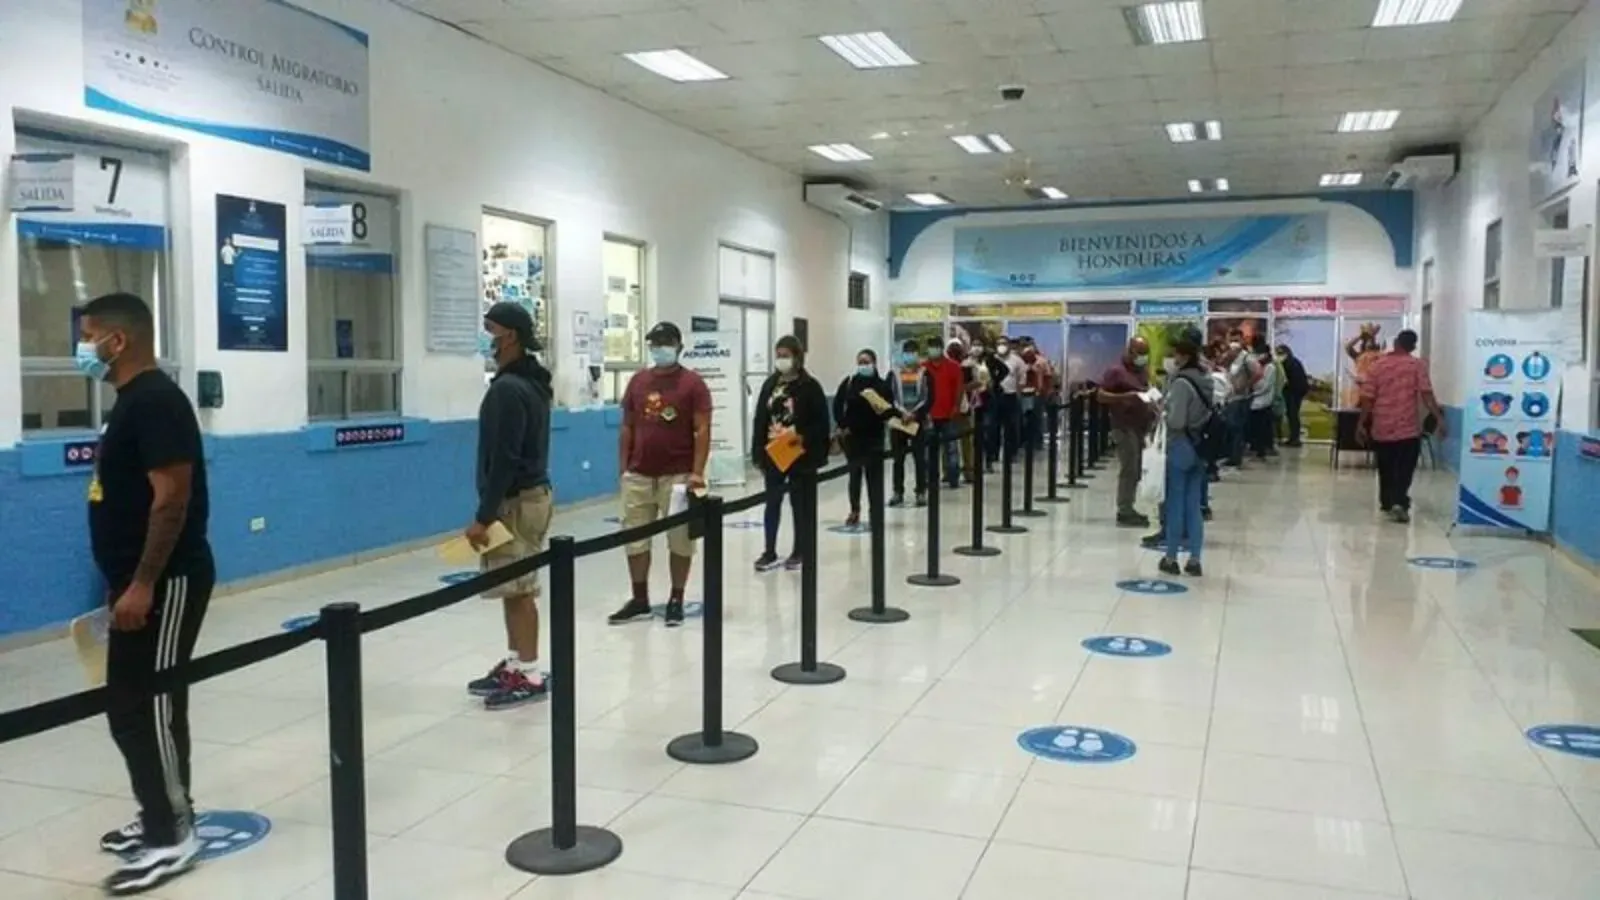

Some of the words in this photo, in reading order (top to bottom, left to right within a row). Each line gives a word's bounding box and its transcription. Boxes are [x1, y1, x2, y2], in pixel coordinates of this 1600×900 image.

[271, 54, 359, 97] MIGRATORIO
[256, 76, 304, 104] SALIDA
[99, 156, 123, 204] 7
[20, 186, 65, 201] SALIDA
[352, 202, 368, 239] 8
[309, 226, 345, 240] SALIDA
[1058, 234, 1188, 253] BIENVENIDOS
[1193, 234, 1208, 248] A
[1077, 251, 1188, 270] HONDURAS
